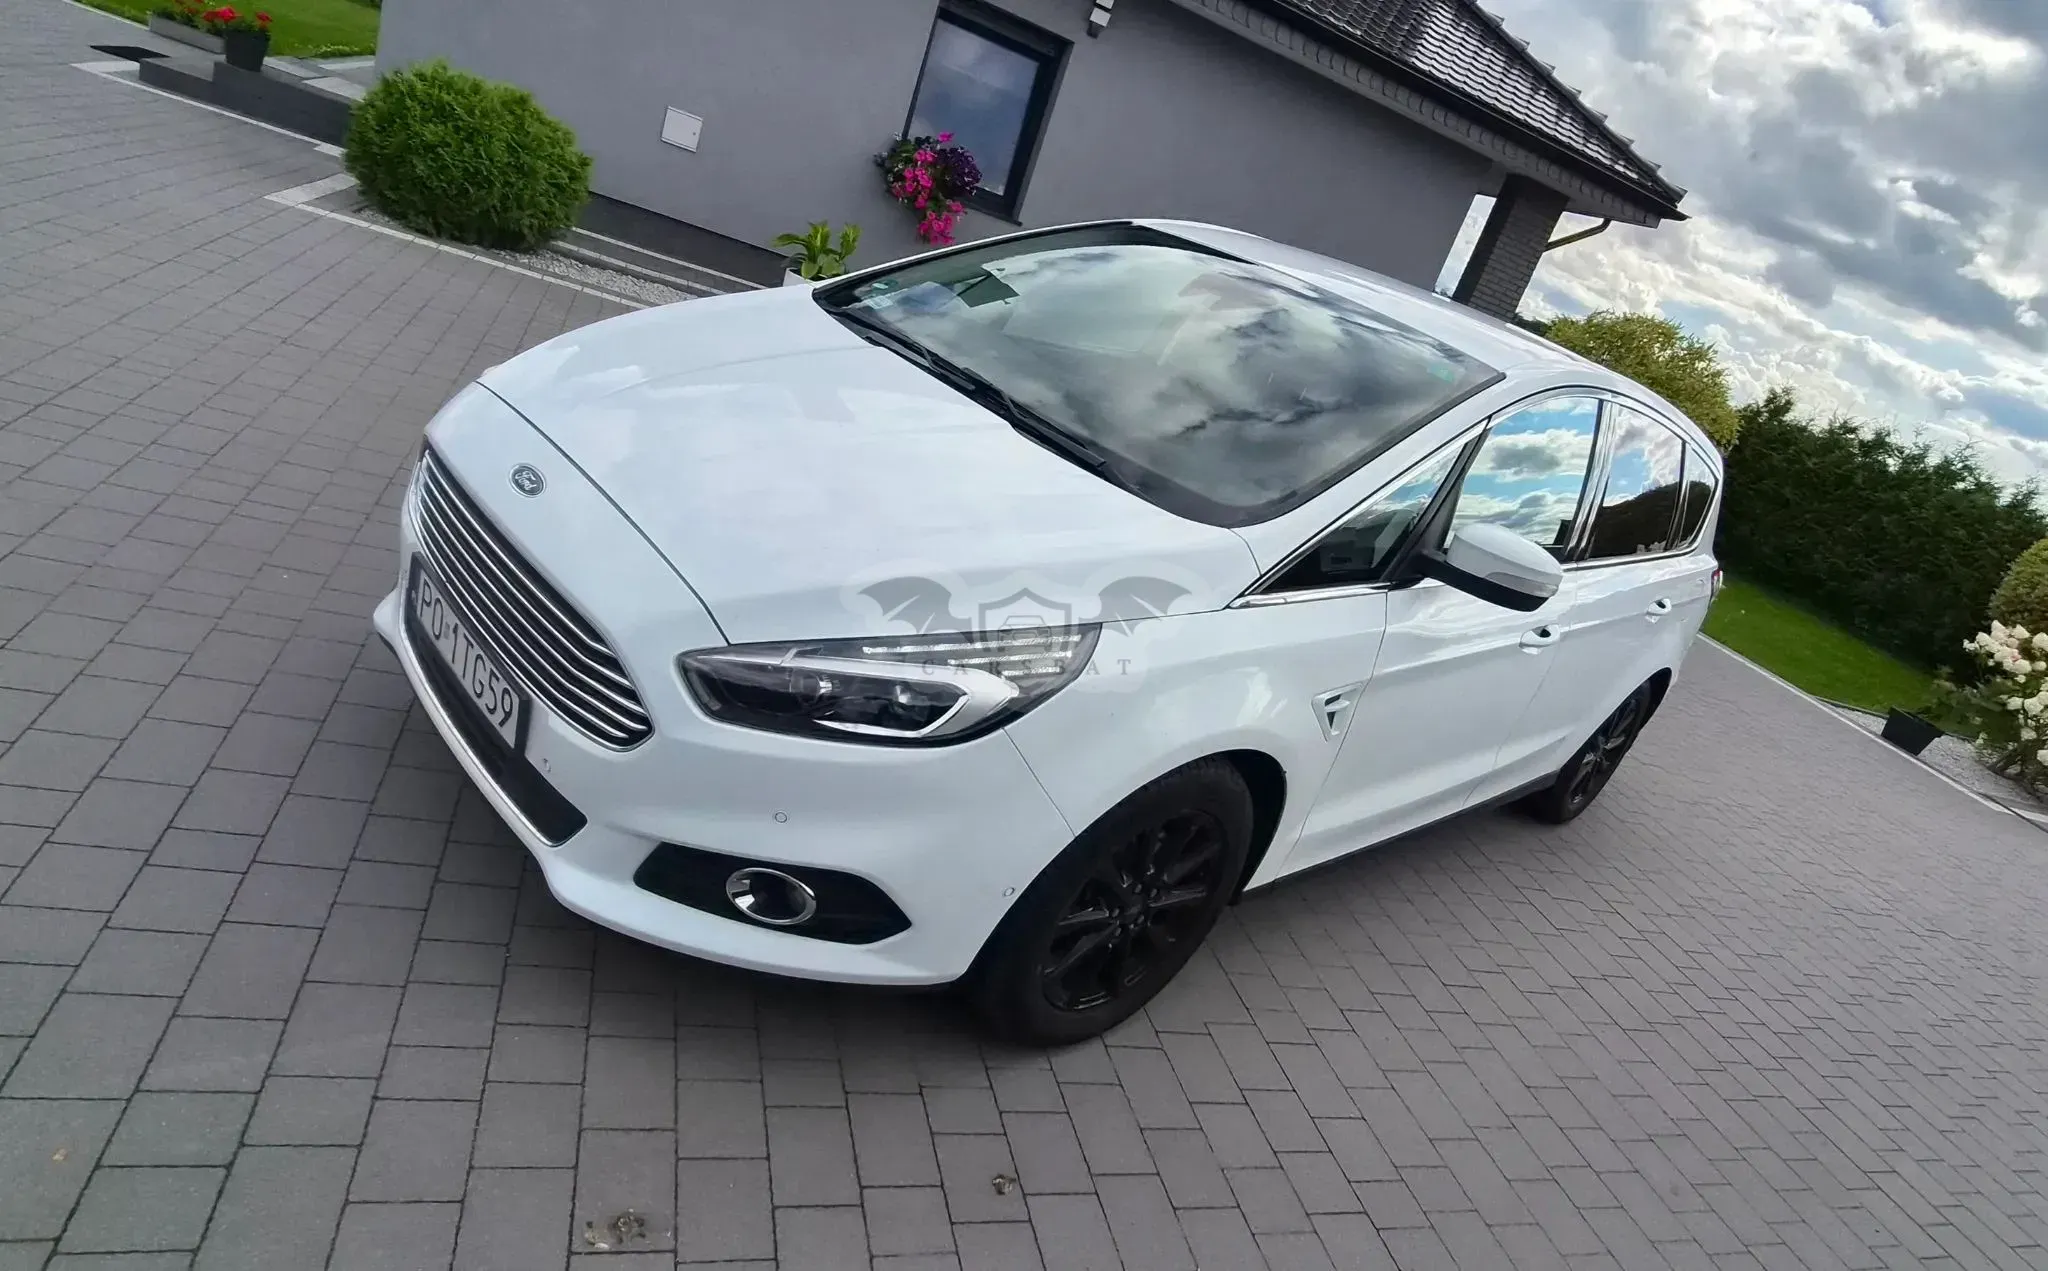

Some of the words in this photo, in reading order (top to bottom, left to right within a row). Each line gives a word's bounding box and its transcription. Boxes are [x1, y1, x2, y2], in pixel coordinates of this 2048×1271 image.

[515, 470, 537, 491] Ford
[420, 578, 444, 640] PO
[452, 622, 514, 728] 1TG59
